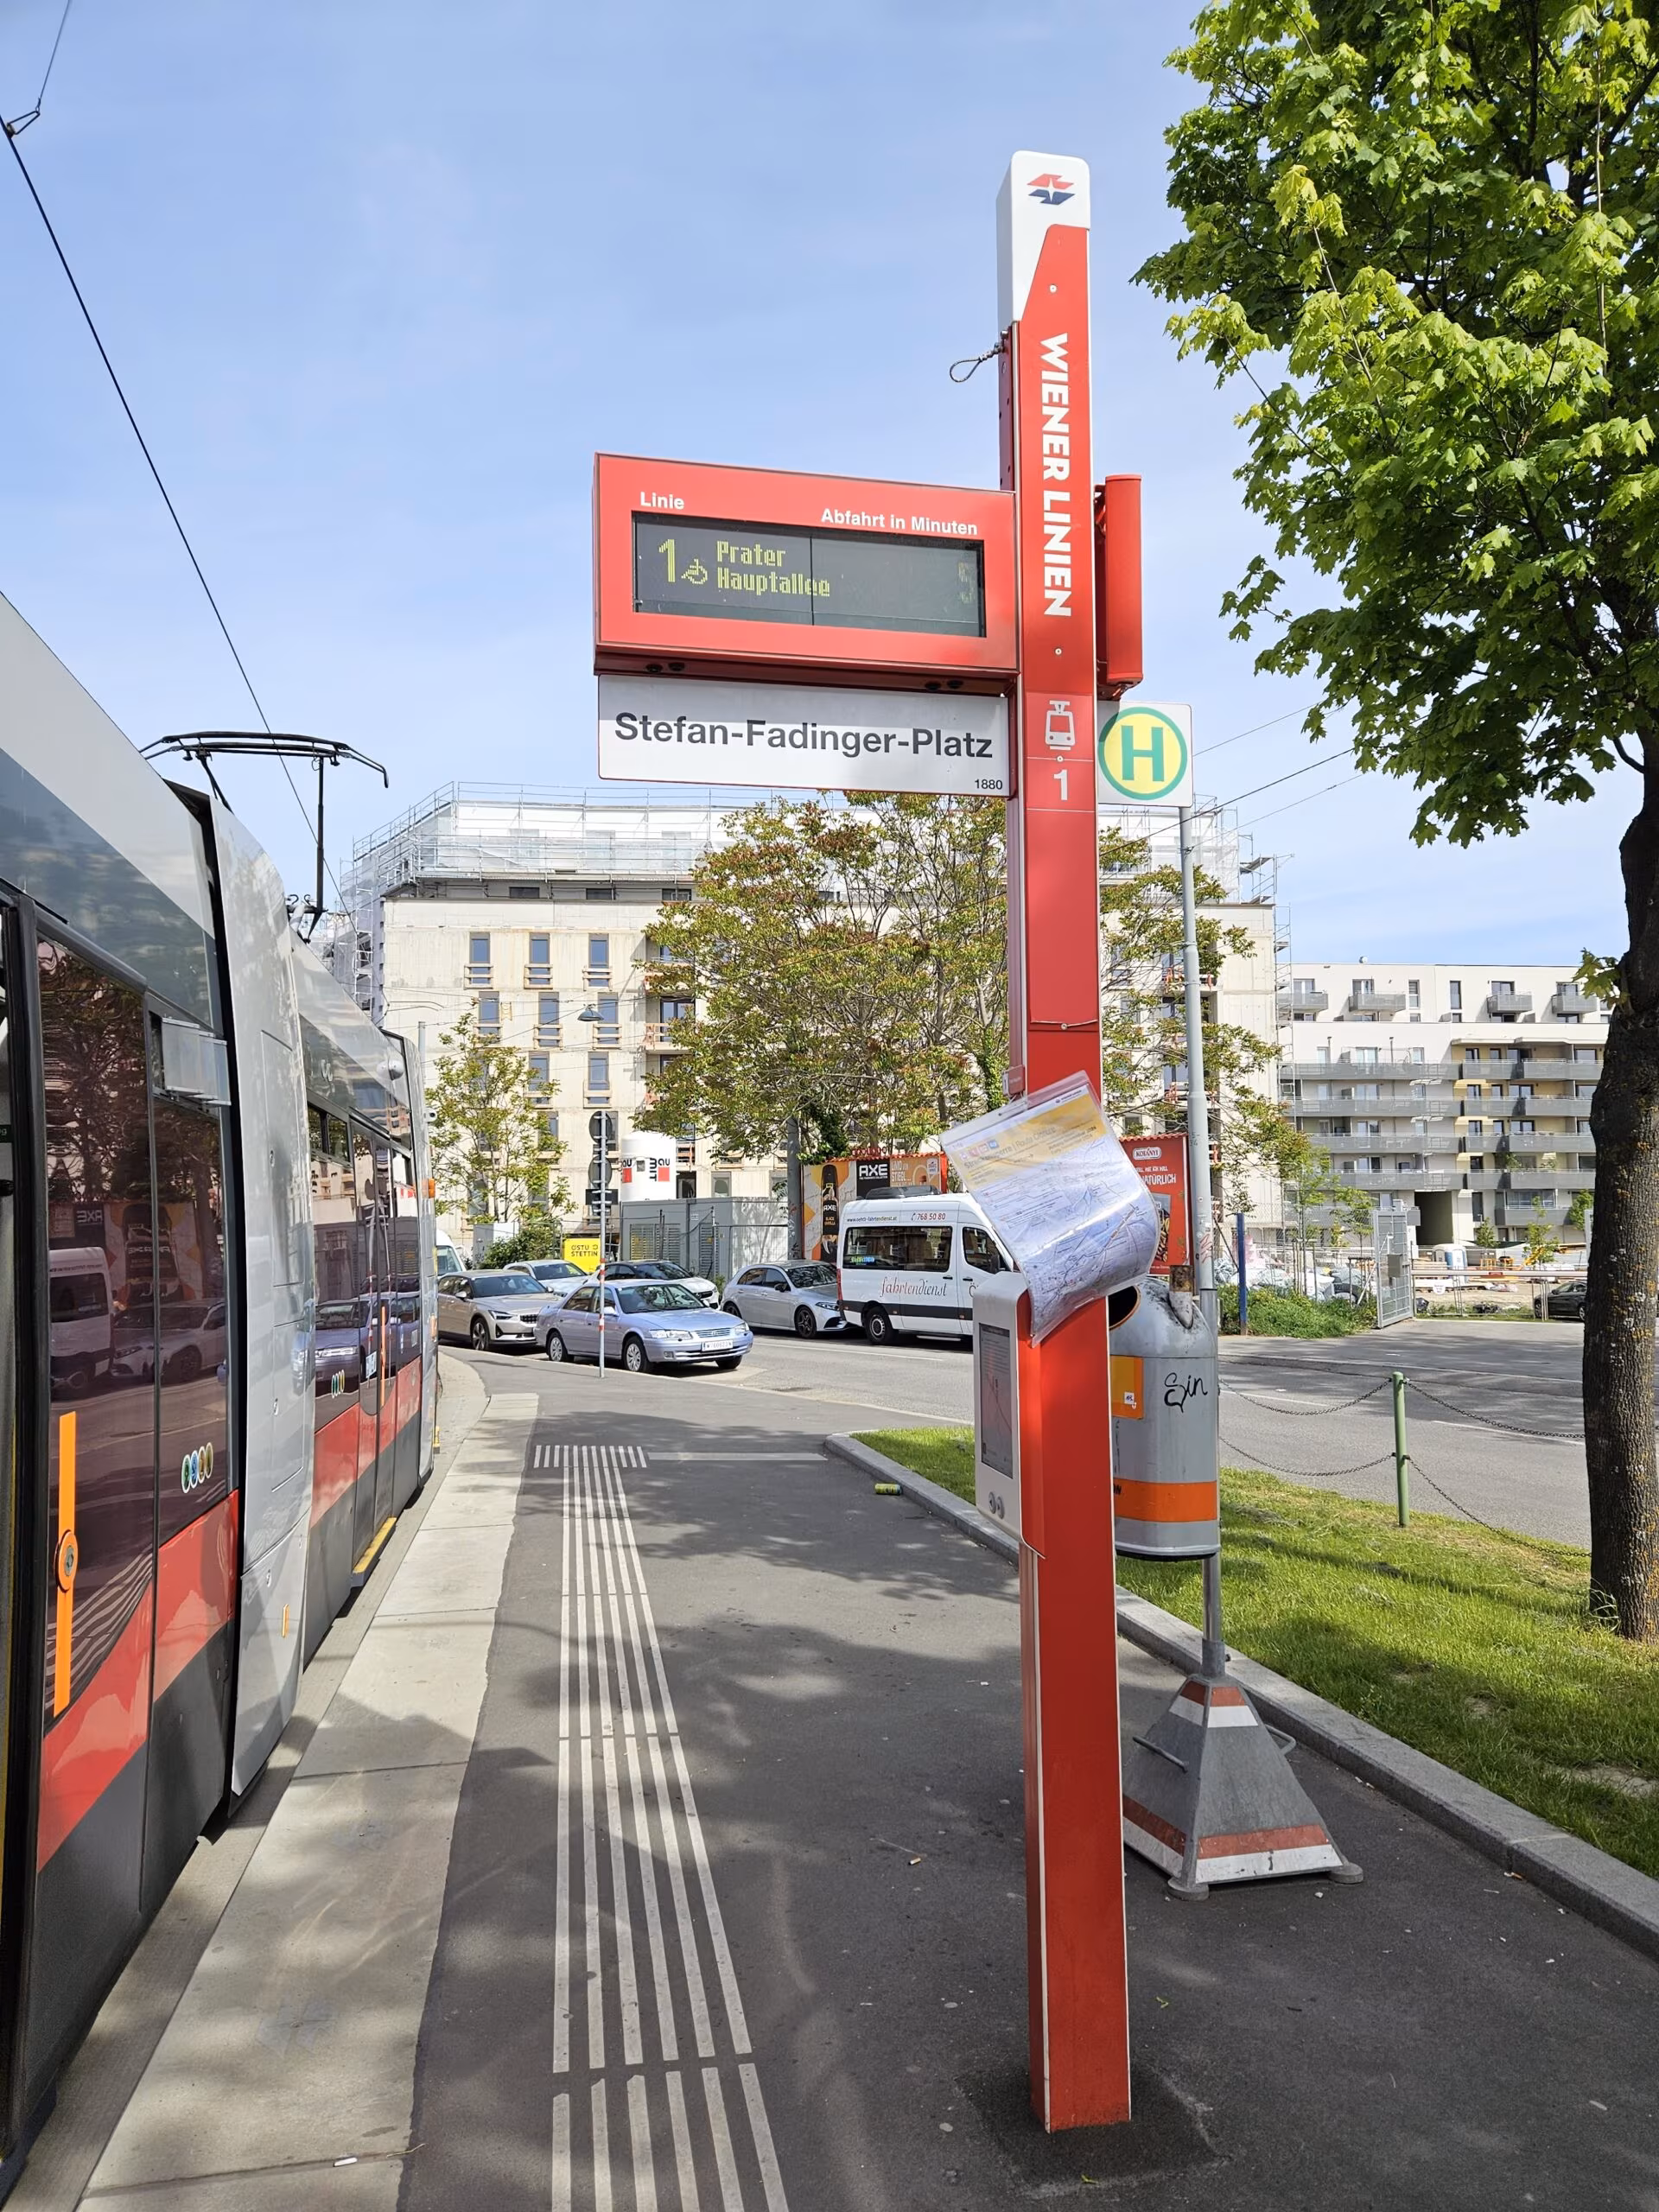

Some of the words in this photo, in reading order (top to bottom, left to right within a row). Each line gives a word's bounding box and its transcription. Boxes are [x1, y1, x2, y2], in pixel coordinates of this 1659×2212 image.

[1040, 333, 1070, 480] WIENER
[640, 492, 685, 510] Linie
[821, 508, 886, 528] Abfahrt
[890, 514, 906, 530] in
[911, 516, 978, 536] Minuten
[658, 538, 676, 583] 1
[716, 540, 786, 568] Prater
[1043, 490, 1071, 617] LINIEN
[717, 567, 830, 598] Hauptallee
[614, 712, 994, 758] Stefan-Fadinger-Platz
[1121, 725, 1165, 782] H
[974, 779, 1003, 791] 1880
[1053, 769, 1068, 801] 1
[859, 1164, 888, 1177] AXE
[917, 1212, 928, 1221] 768
[880, 1276, 948, 1298] fahrtendienst
